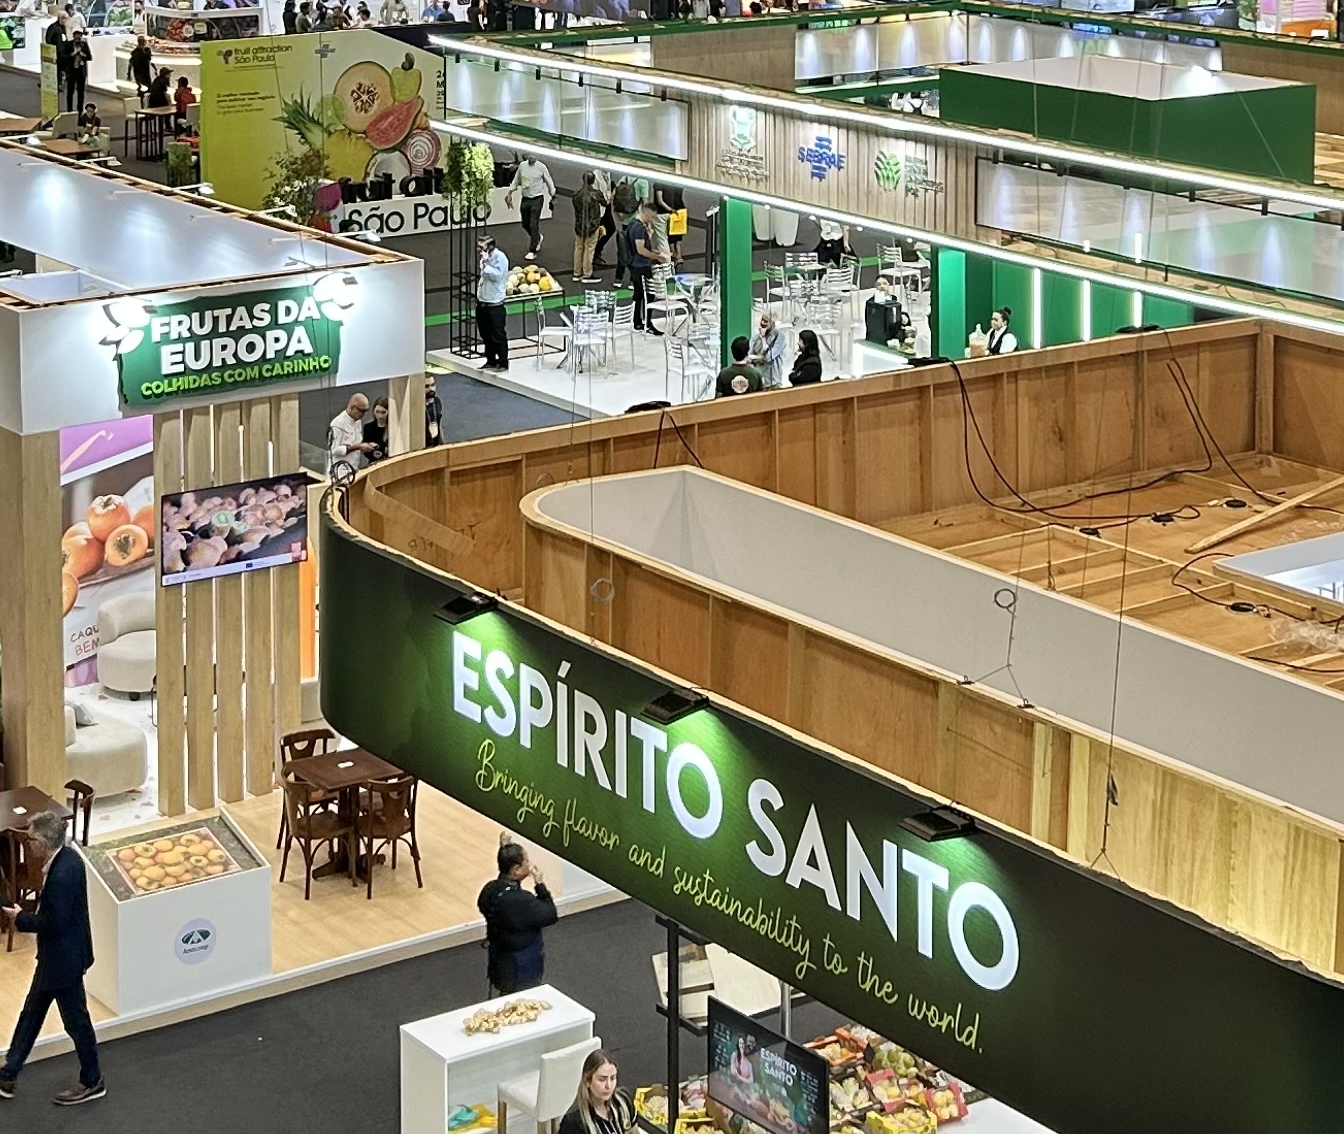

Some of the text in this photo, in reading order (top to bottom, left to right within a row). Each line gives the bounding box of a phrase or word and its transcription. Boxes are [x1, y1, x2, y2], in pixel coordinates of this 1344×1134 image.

[798, 146, 847, 172] SEBRAE
[346, 205, 406, 235] São
[151, 296, 322, 343] FRUTAS DA
[160, 326, 315, 377] EUROPA
[141, 354, 334, 397] COLHIDAS COM CARINHO
[453, 630, 1021, 992] ESPÍRITO SANTO
[475, 738, 984, 1054] Bringing flavor and sustainability to the world.
[760, 1047, 798, 1077] ESPÍRITO
[763, 1061, 794, 1087] SANTO
